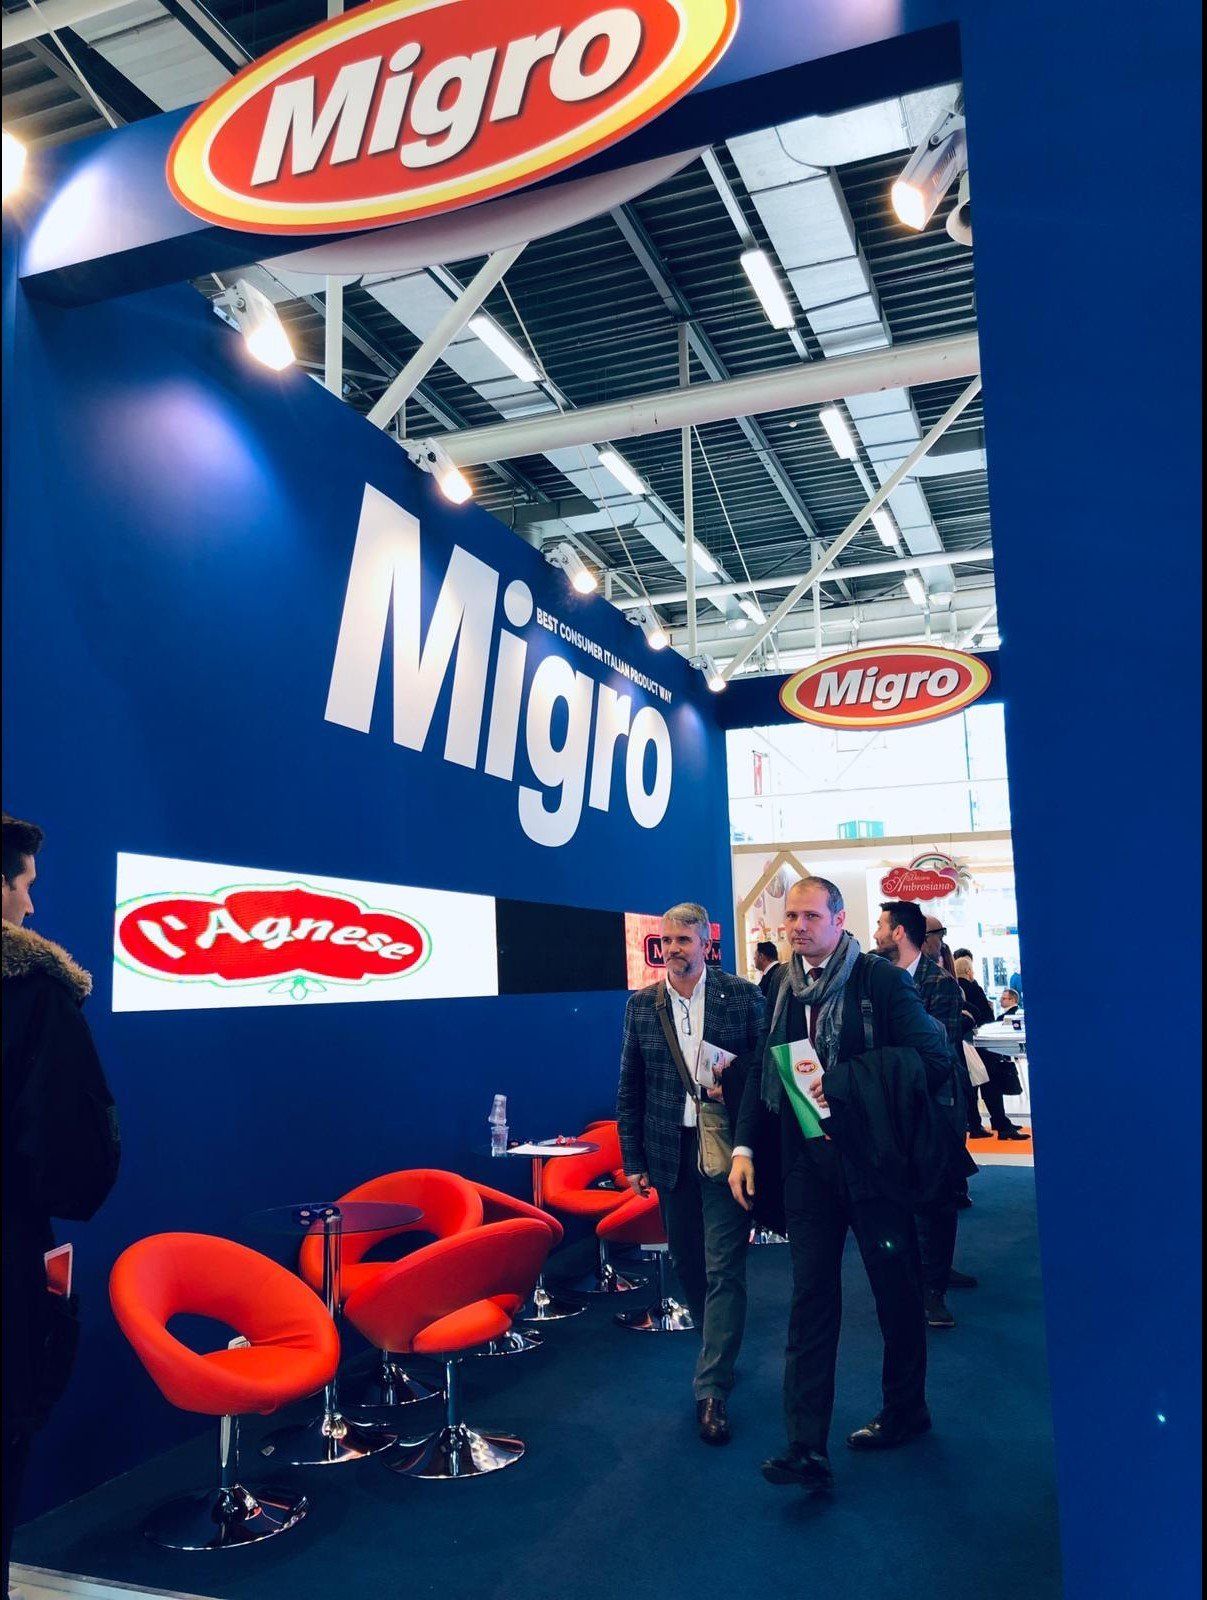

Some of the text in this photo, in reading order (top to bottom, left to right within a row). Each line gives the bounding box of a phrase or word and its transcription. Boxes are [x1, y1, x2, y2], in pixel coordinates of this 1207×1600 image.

[250, 8, 642, 187] Migro
[324, 482, 673, 847] Migro
[537, 606, 672, 704] BEST CONSUMER ITALIAN PRODUCT WAY
[814, 666, 959, 711] Migro
[882, 872, 950, 894] Ambrosiana
